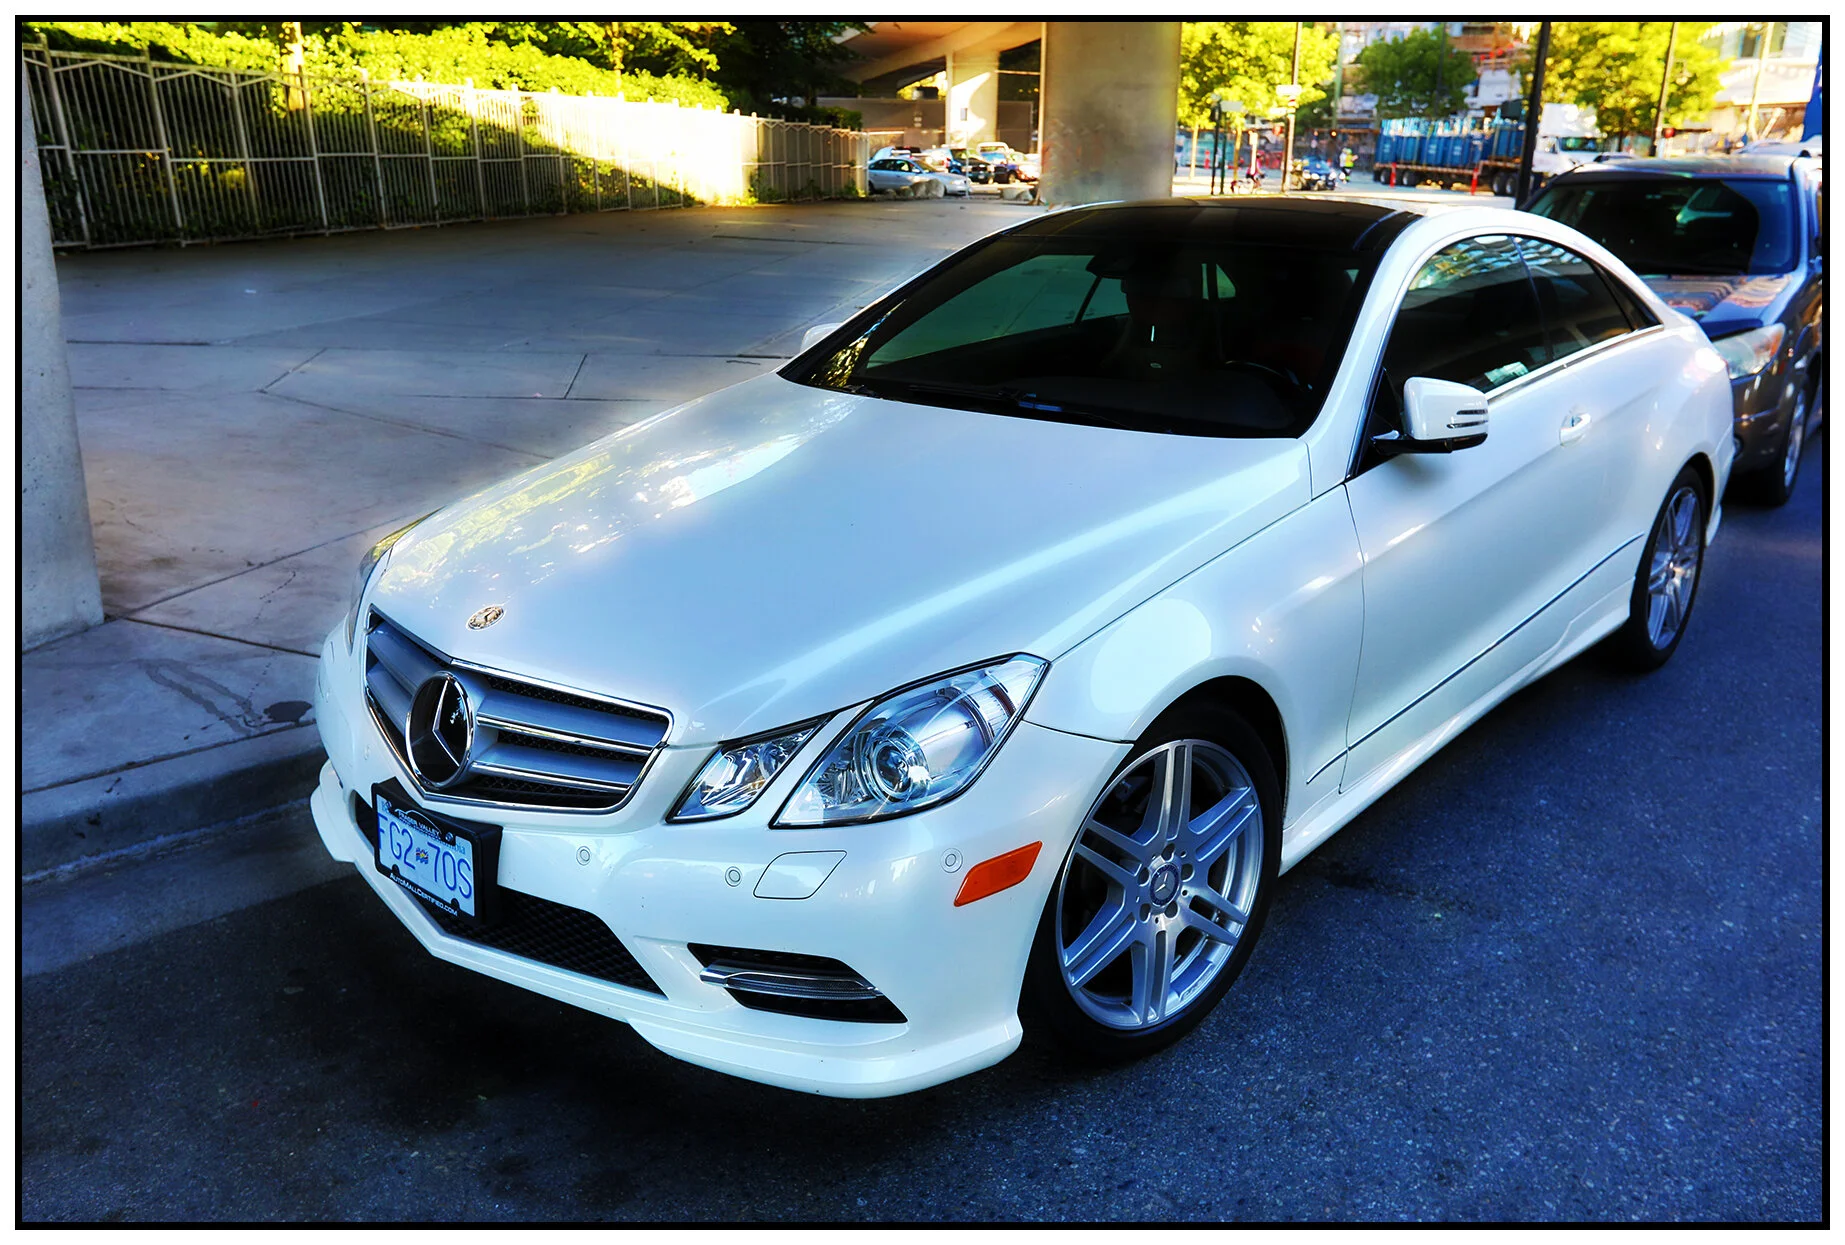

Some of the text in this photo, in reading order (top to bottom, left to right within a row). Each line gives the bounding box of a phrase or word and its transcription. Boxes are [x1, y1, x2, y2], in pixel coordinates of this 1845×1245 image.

[417, 822, 440, 837] VALLEY
[377, 812, 416, 870] FG2
[427, 841, 472, 899] 70S
